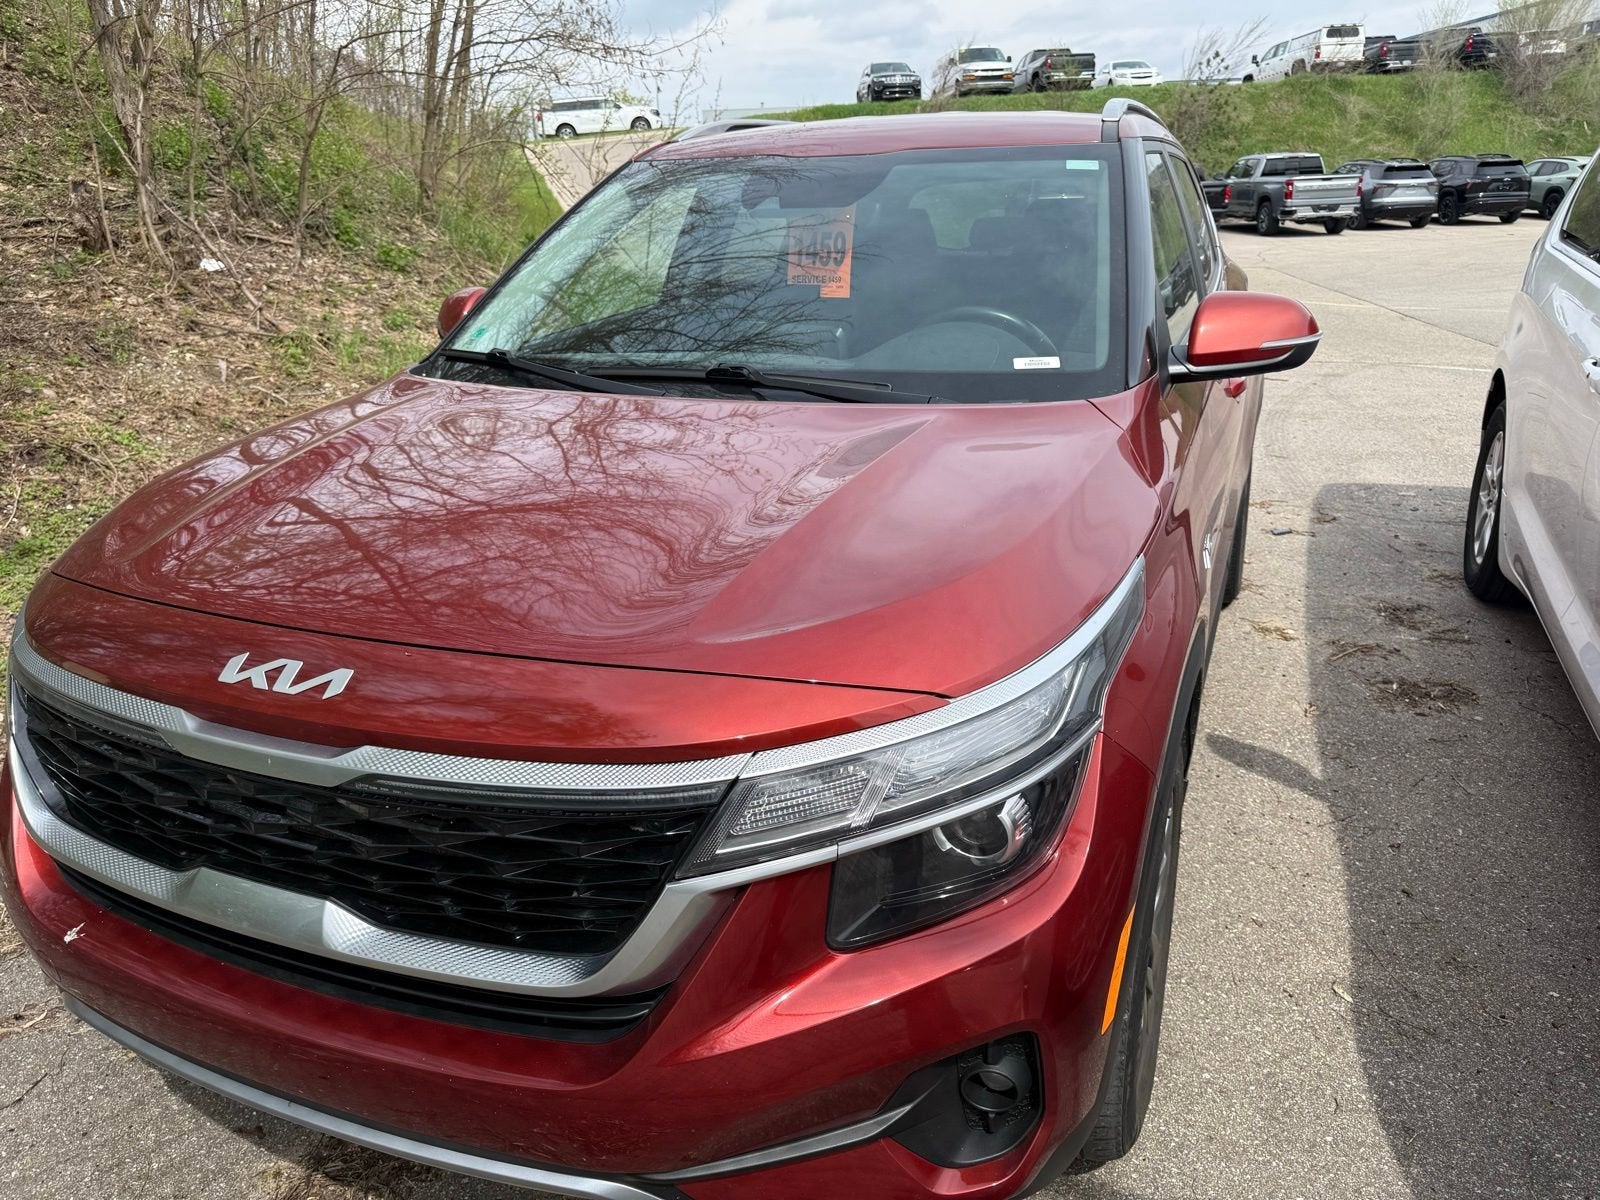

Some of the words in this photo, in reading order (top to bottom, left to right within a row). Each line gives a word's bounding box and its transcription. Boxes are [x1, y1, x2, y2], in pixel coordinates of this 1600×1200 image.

[795, 231, 847, 267] 1459
[791, 274, 826, 284] SERVICE
[218, 651, 354, 700] KIA
